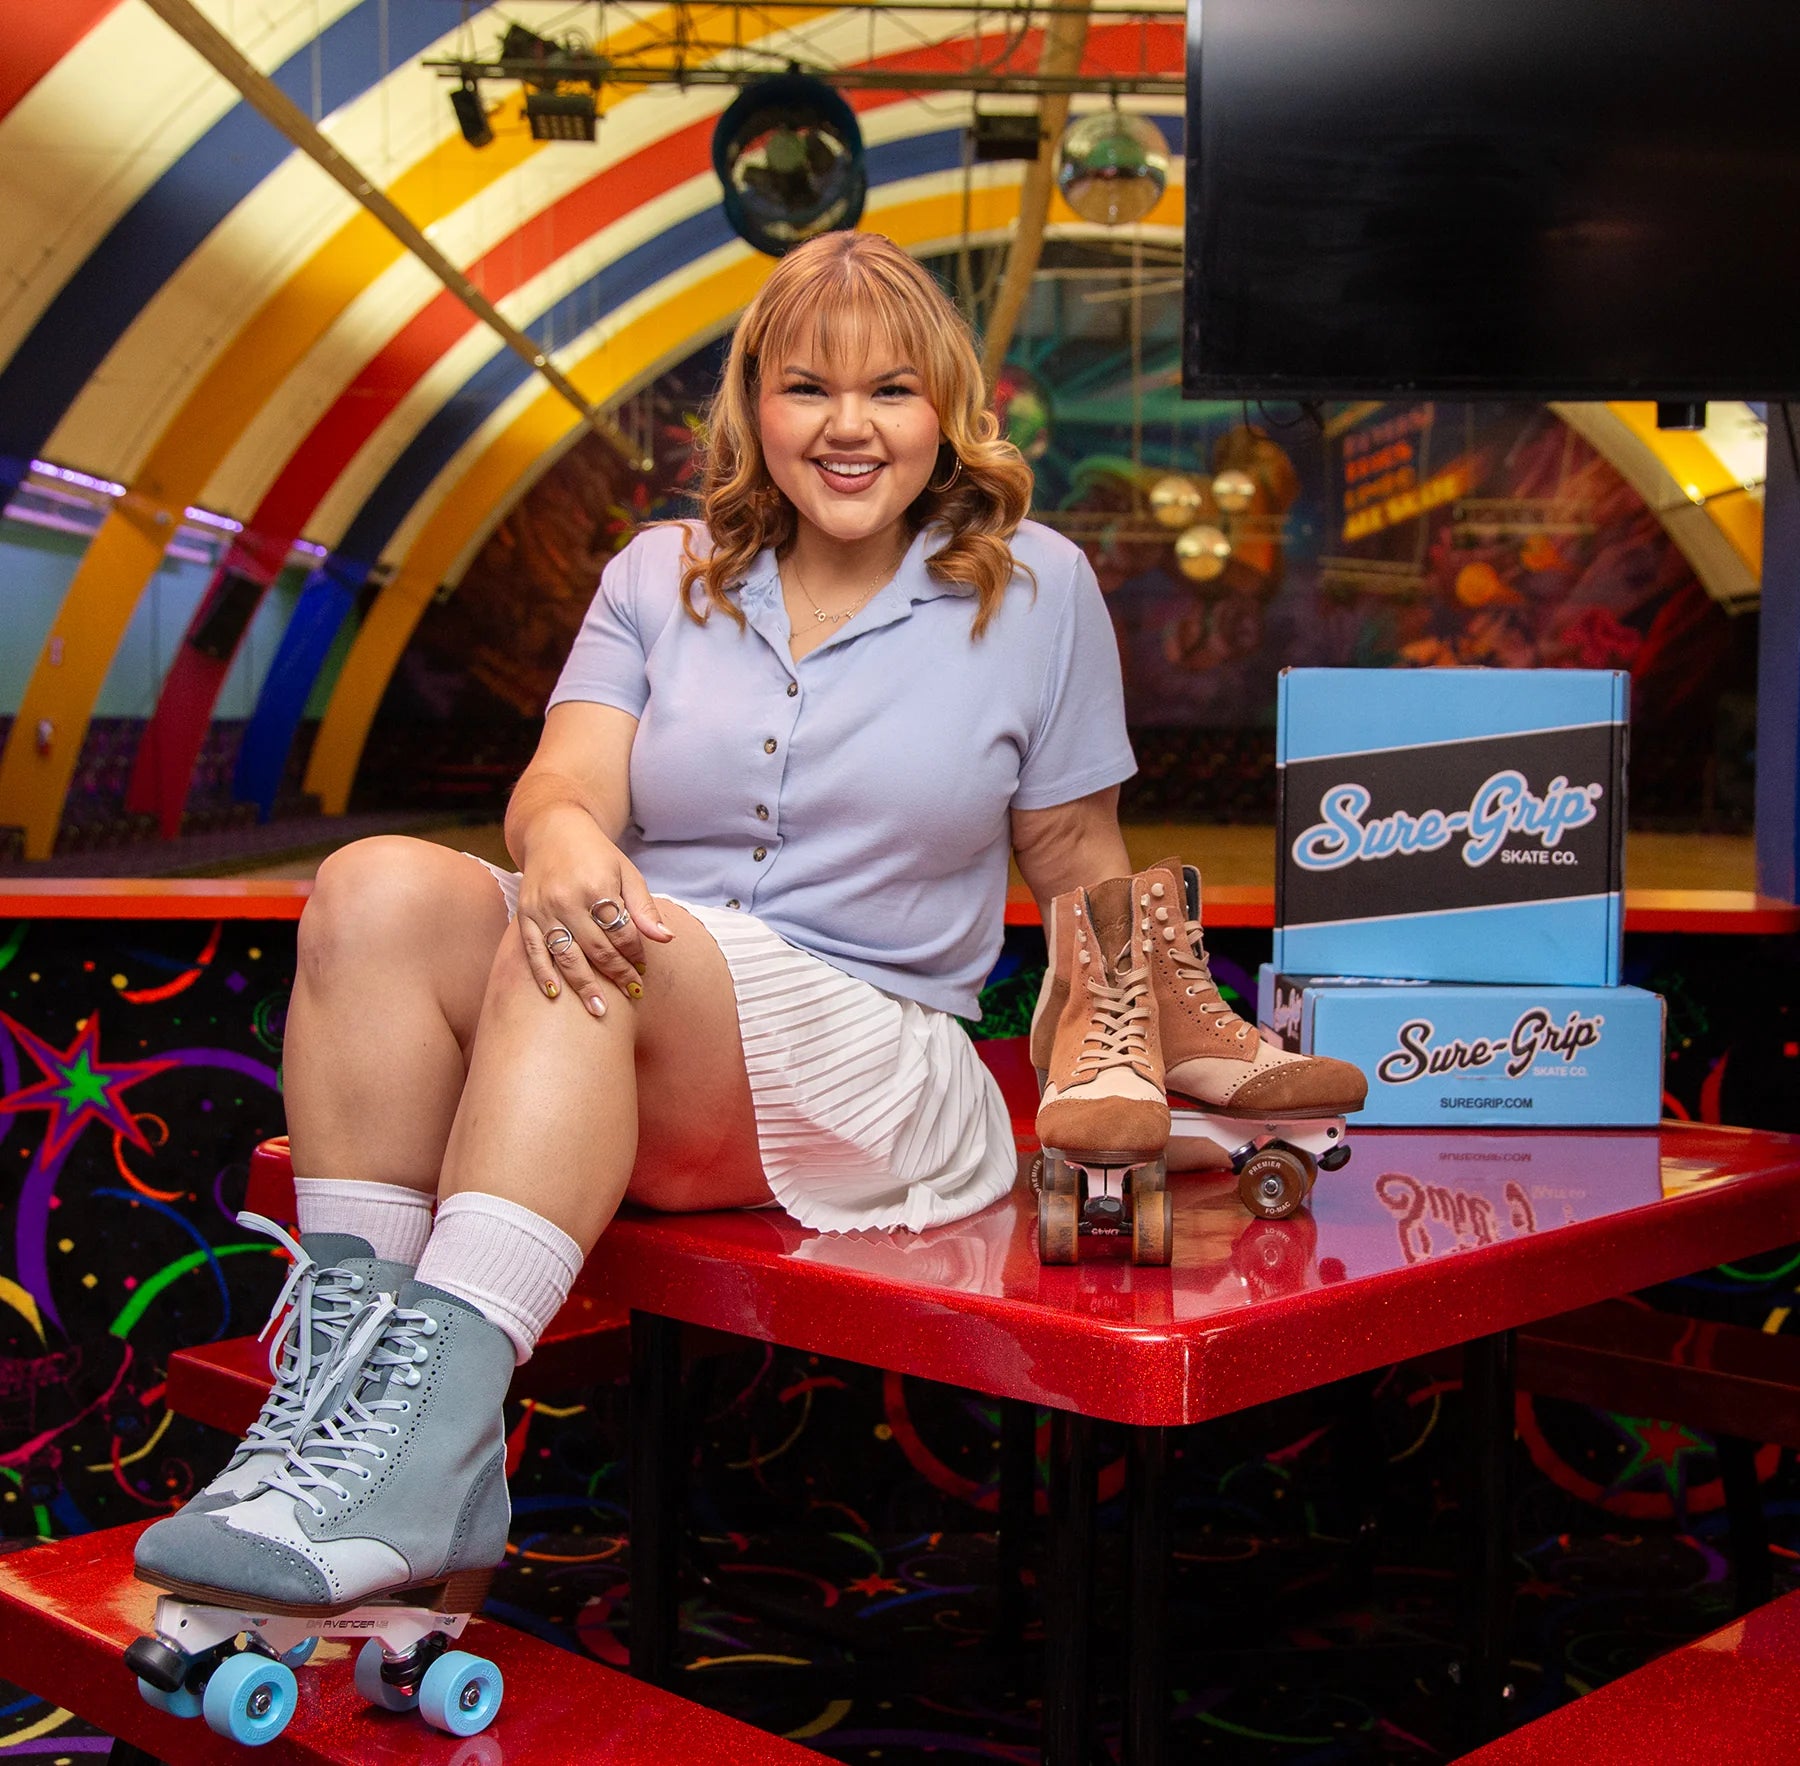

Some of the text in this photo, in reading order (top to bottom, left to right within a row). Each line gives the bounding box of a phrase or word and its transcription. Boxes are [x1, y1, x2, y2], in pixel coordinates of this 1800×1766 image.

[1500, 849, 1578, 865] SKATE CO.
[1533, 1066, 1568, 1076] SKATE
[1440, 1097, 1533, 1109] SUREGRIP.COM
[1248, 1160, 1281, 1175] PREMIER
[1265, 1201, 1291, 1214] FO-MAC
[323, 1620, 375, 1628] AVENGER
